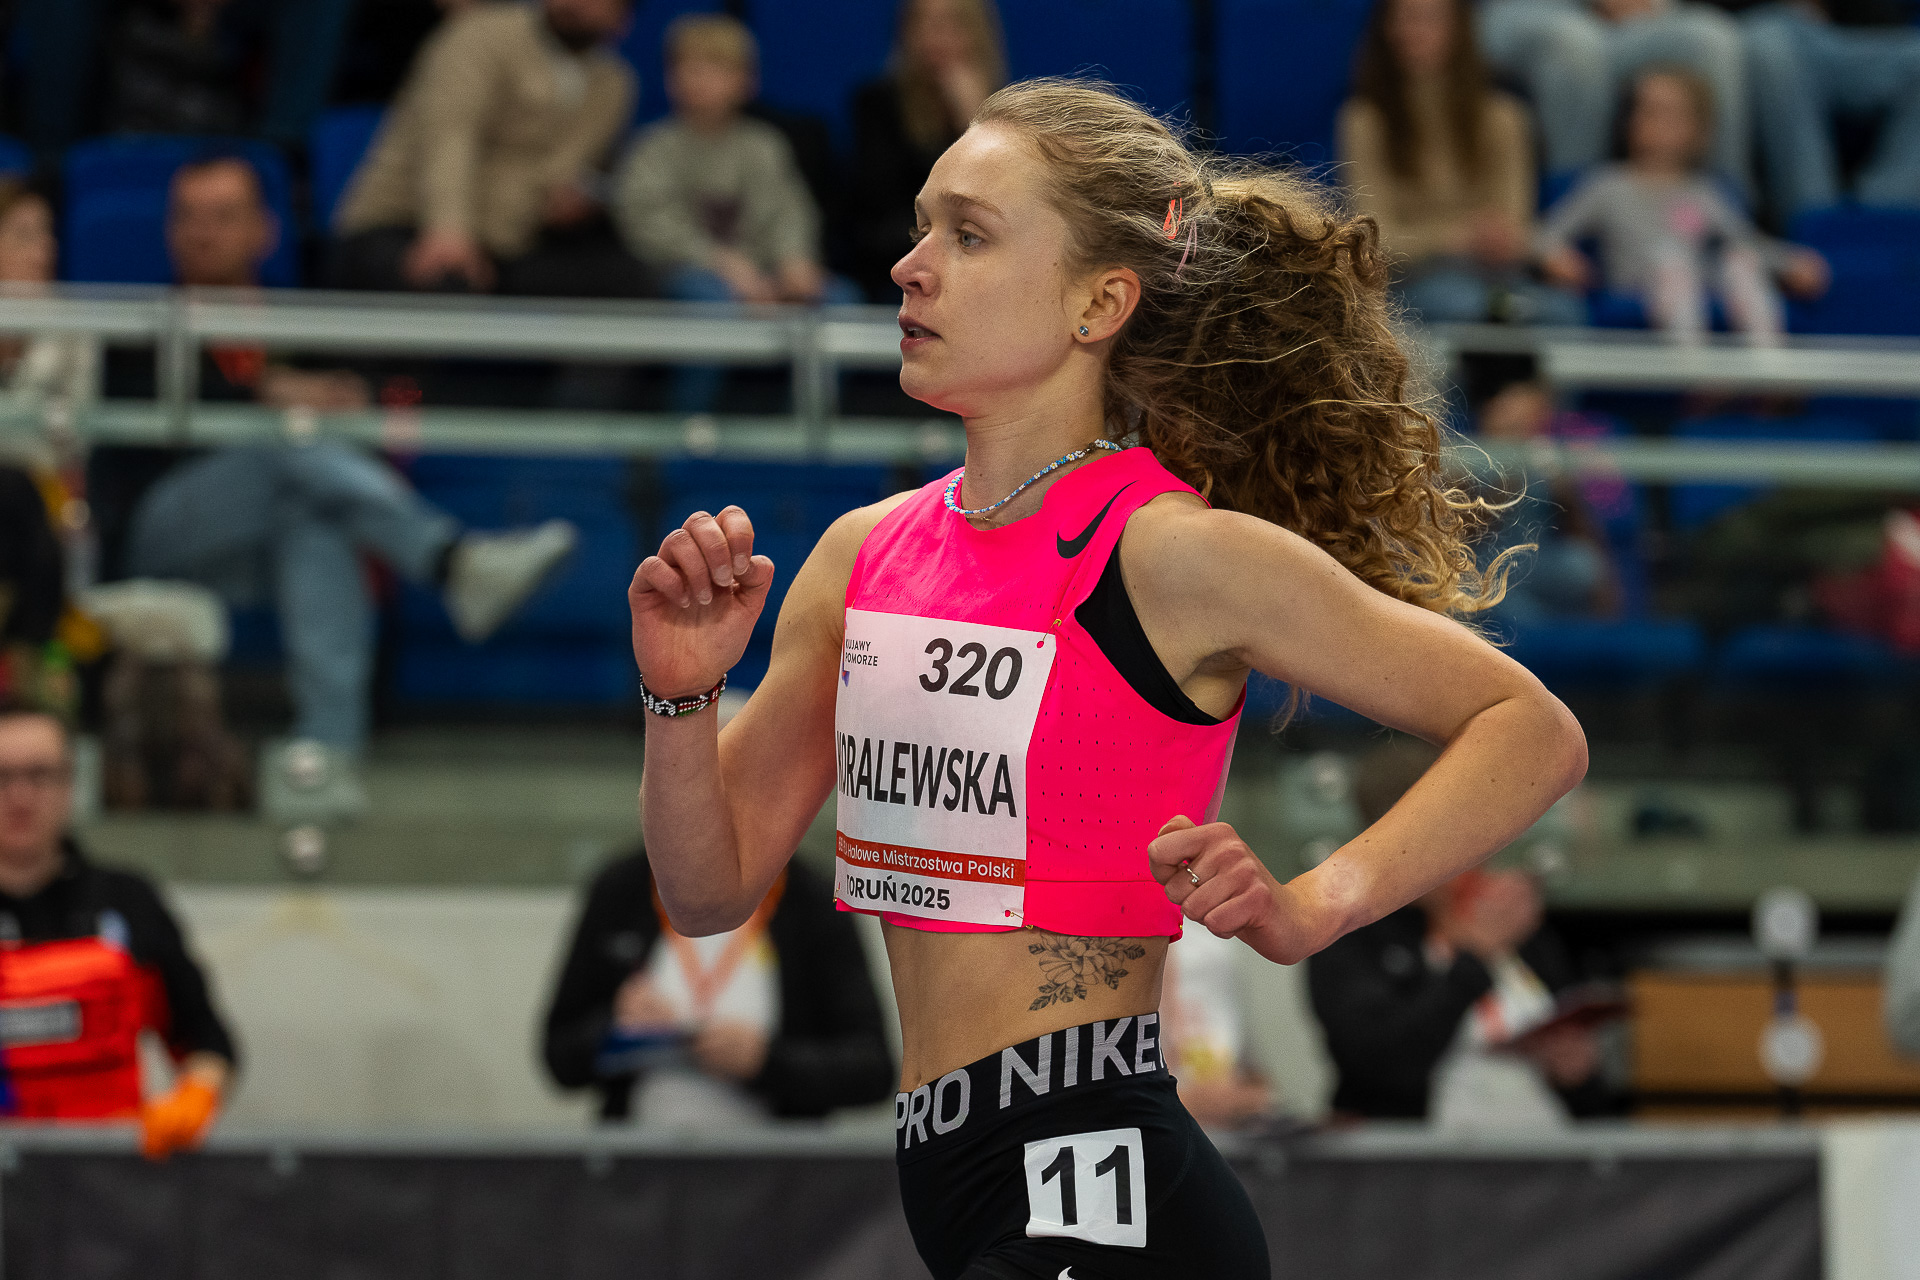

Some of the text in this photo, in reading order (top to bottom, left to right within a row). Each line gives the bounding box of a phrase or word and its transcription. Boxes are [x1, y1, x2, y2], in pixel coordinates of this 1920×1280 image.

[845, 652, 879, 666] POMORZE
[919, 638, 1023, 700] 320
[848, 843, 880, 862] Halowe
[883, 850, 963, 874] Mistrzostwa
[968, 860, 1015, 879] Polski
[846, 874, 950, 910] TORUŃ 2025
[896, 1013, 1157, 1149] PRO NIKE
[1041, 1144, 1133, 1226] 11
